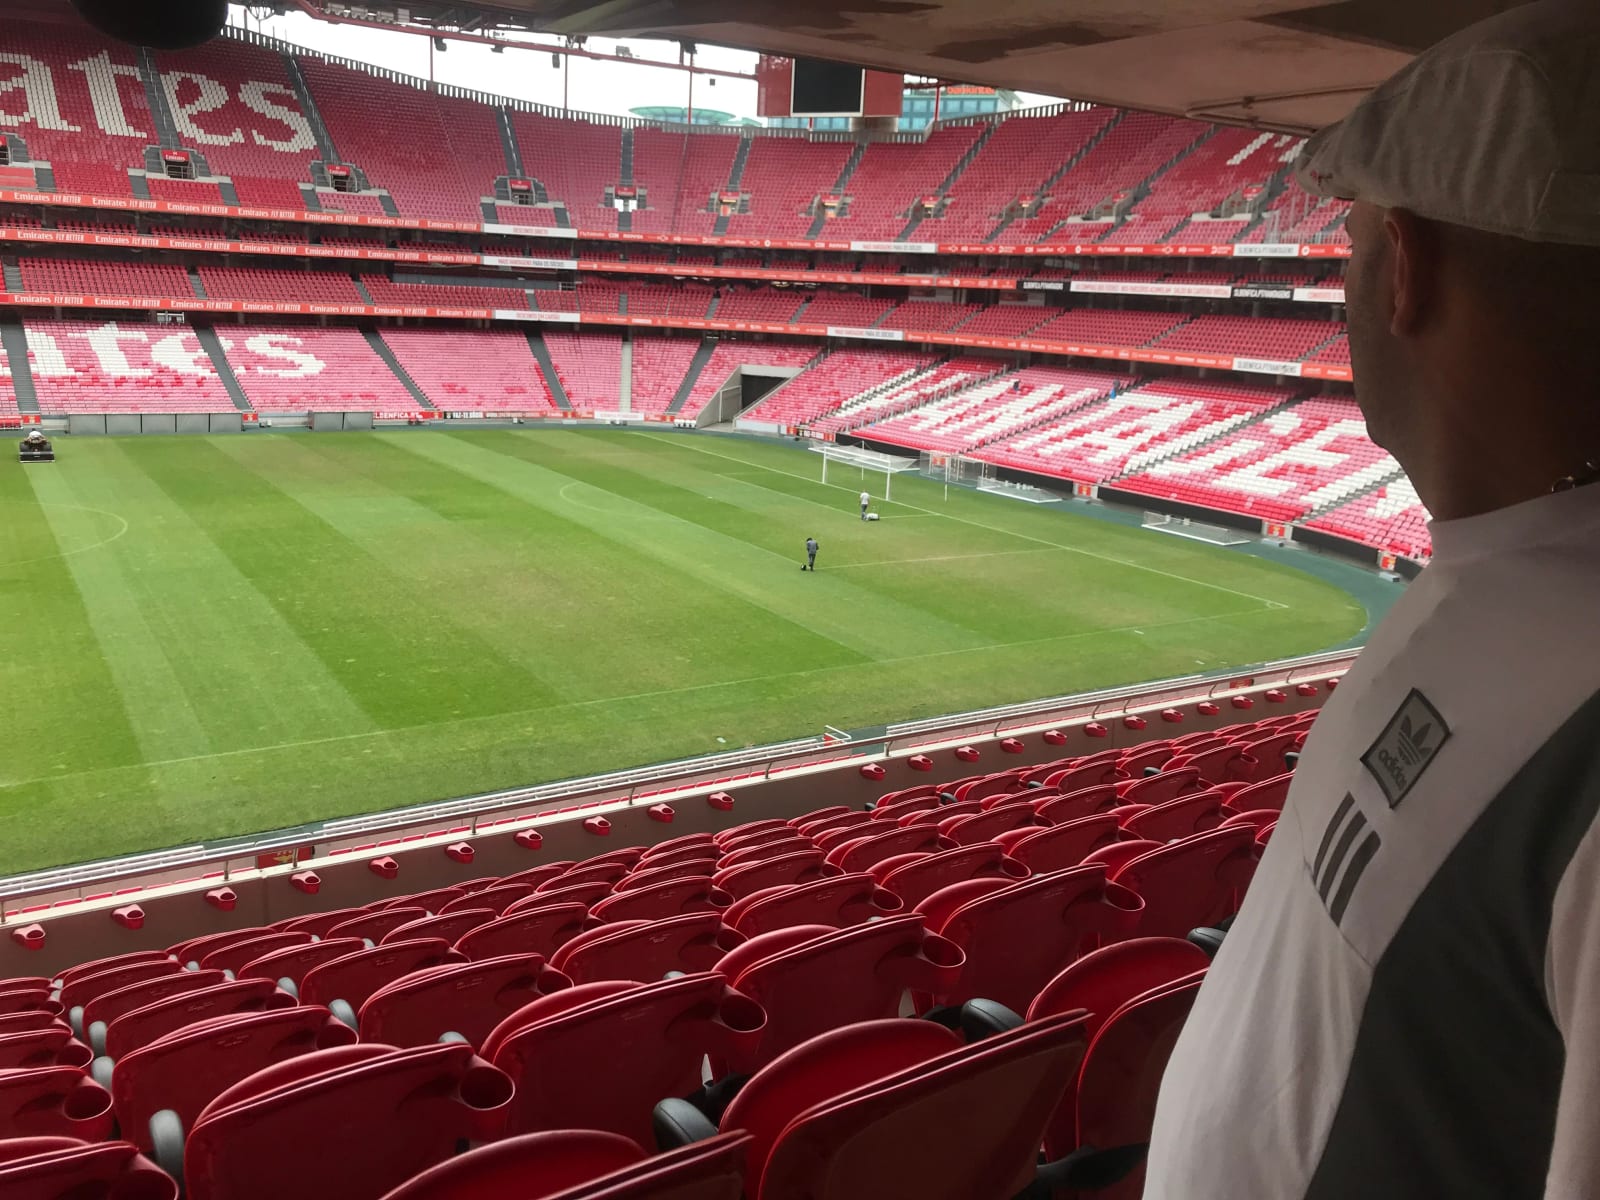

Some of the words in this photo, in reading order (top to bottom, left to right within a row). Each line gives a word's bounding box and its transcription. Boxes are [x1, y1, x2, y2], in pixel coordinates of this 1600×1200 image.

[14, 192, 50, 202] Emirates
[62, 195, 81, 204] BETTER
[92, 198, 126, 207] Emirates
[167, 203, 199, 212] Emirates
[238, 208, 268, 217] Emirates
[18, 231, 53, 240] Emirates
[96, 235, 129, 244] Emirates
[170, 240, 202, 248] Emirates
[240, 244, 269, 252] Emirates
[15, 295, 51, 303] Emirates
